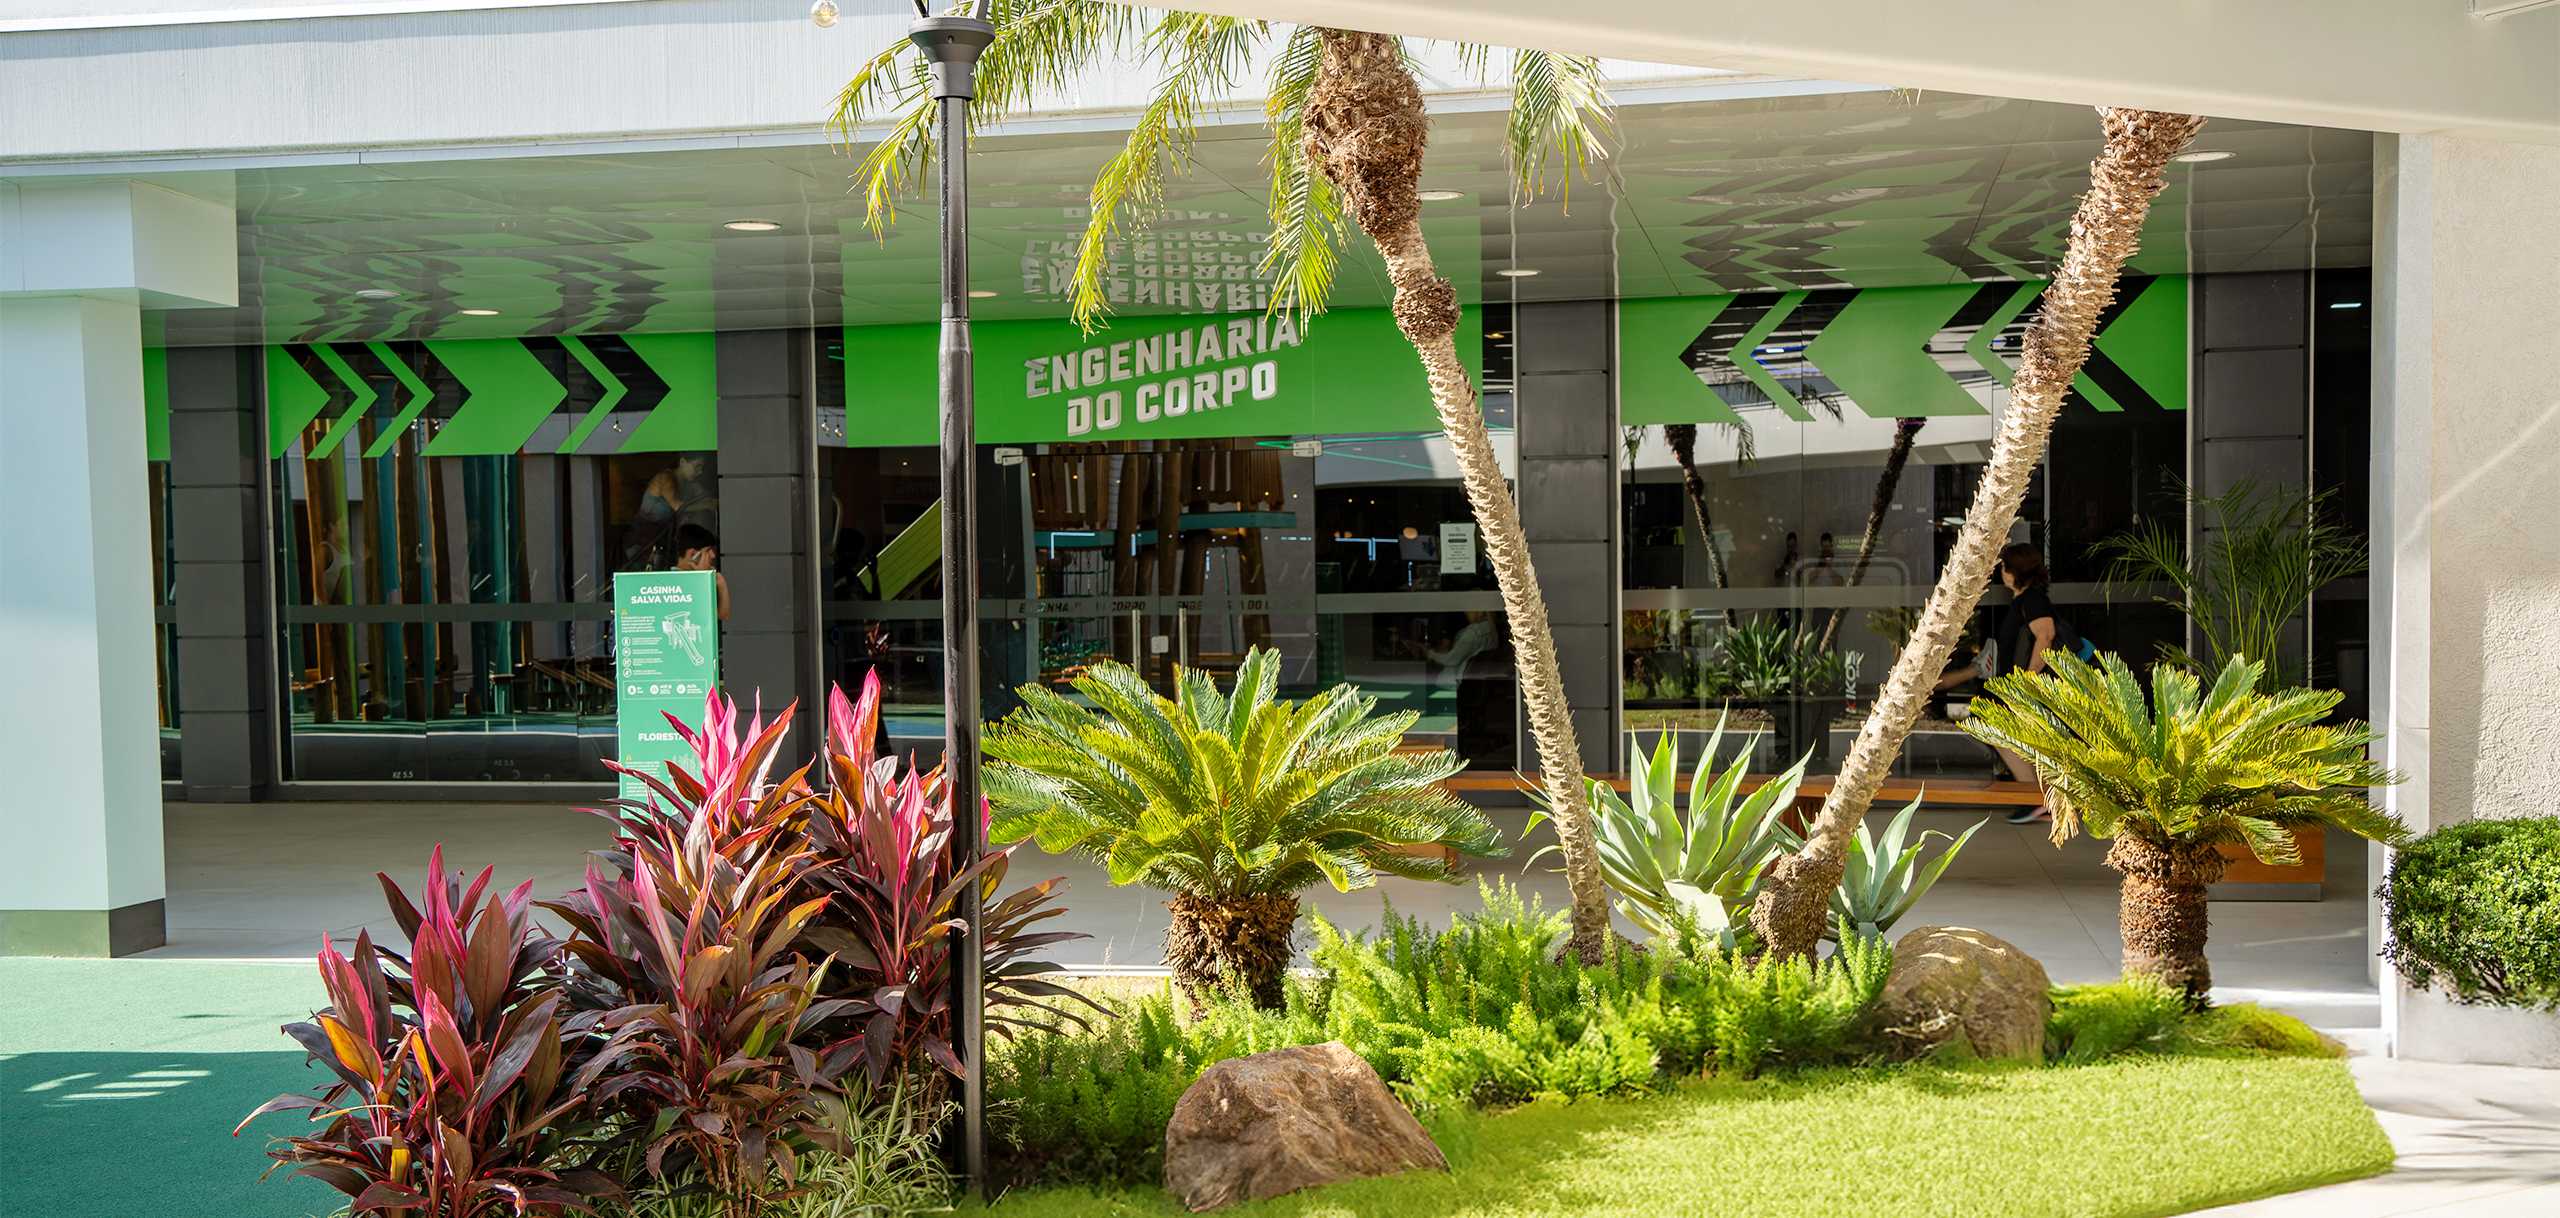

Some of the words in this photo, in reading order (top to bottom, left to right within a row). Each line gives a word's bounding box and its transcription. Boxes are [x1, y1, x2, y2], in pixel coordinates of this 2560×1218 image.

[1024, 313, 1301, 399] ENGENHARIA
[1068, 390, 1122, 437] DO
[1136, 360, 1278, 423] CORPO
[631, 595, 662, 604] SALVA
[663, 594, 693, 603] VIDAS
[640, 586, 683, 595] CASINHA
